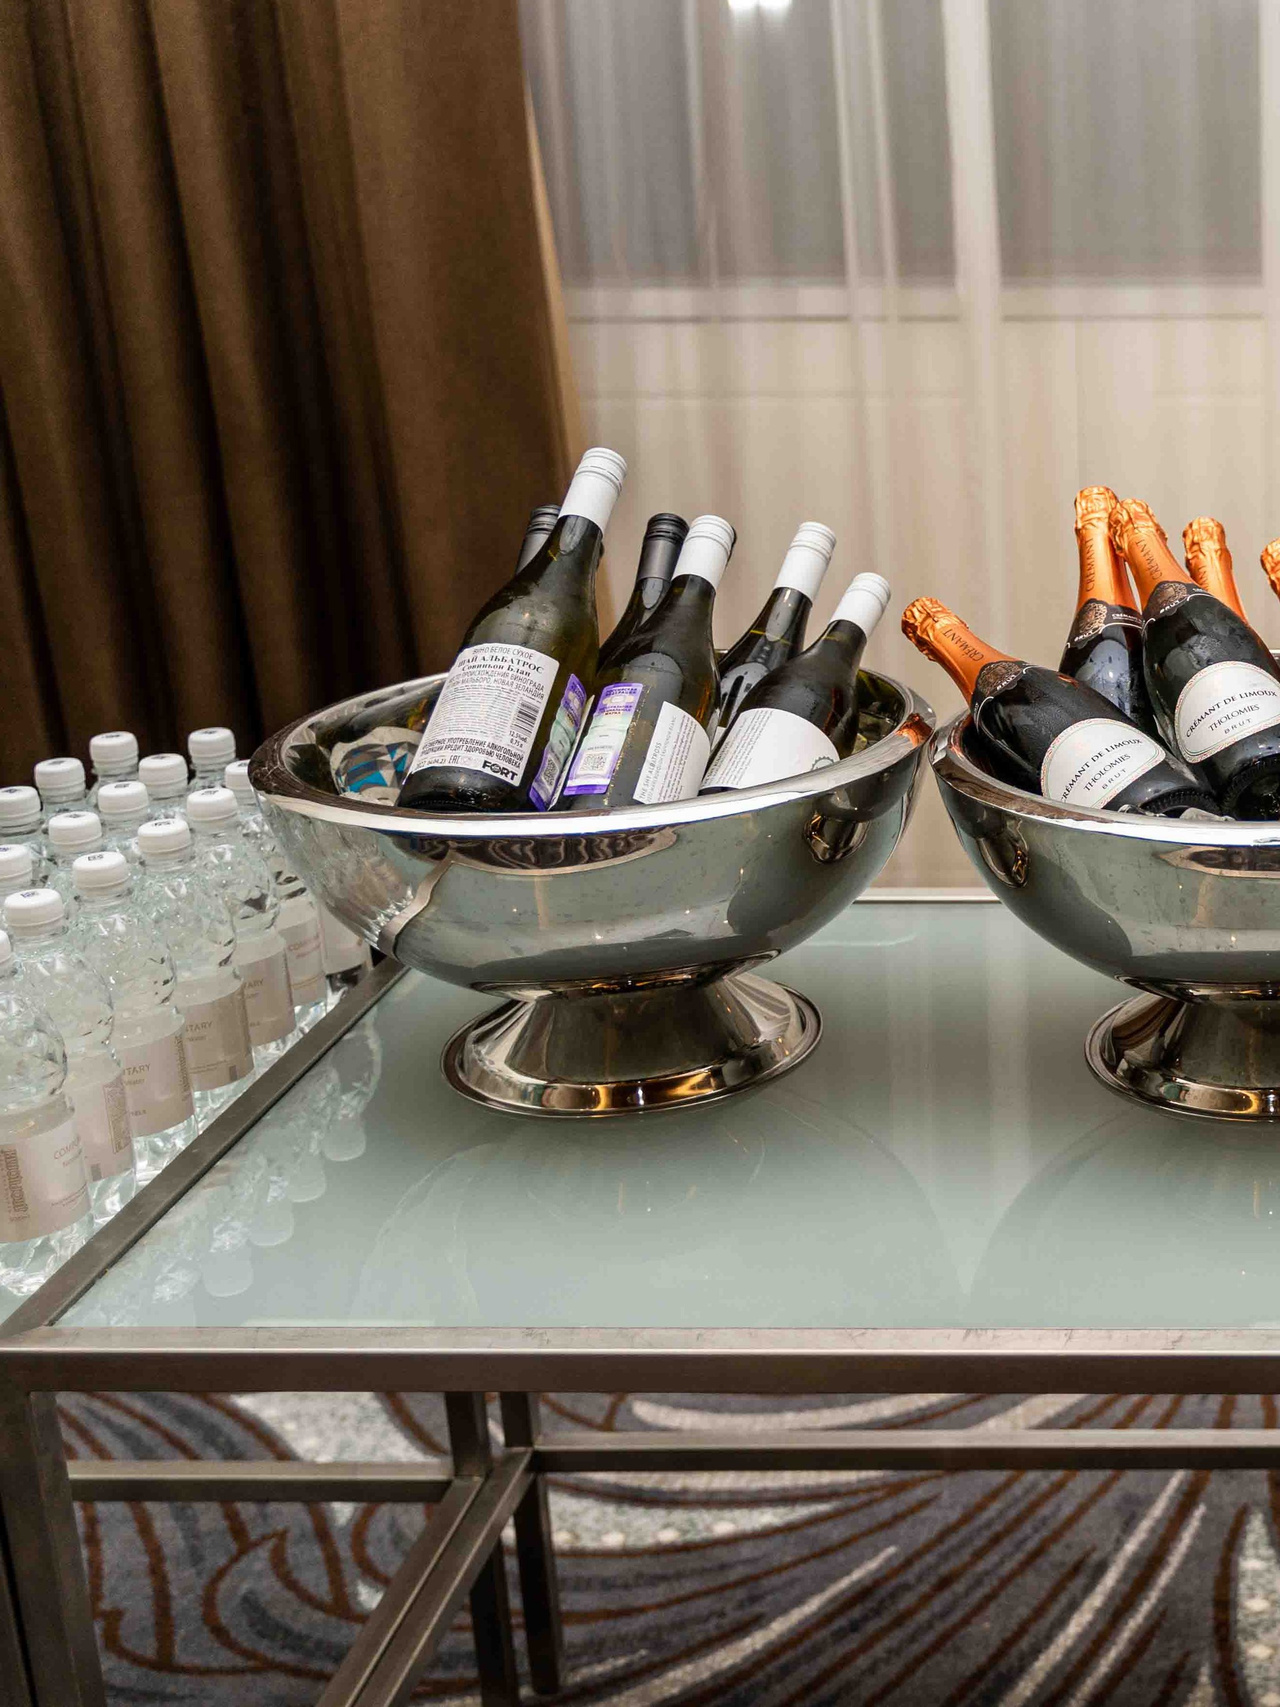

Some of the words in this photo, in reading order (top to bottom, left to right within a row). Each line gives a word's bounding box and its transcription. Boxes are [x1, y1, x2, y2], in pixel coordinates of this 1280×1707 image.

[1136, 539, 1163, 580] CRÉMANT
[489, 645, 511, 655] БЕЛОЕ
[511, 648, 535, 660] СУХОЕ
[942, 628, 984, 662] CRÉMANT
[480, 655, 544, 675] АЛЬБАТРОС
[507, 664, 532, 678] Блан
[511, 672, 545, 692] ВИНОГРАДА
[514, 682, 545, 701] ЗЕЛАНДИЯ
[1186, 701, 1222, 738] CRÉMANT
[1223, 696, 1236, 705] DE
[1239, 690, 1278, 699] LIMOUX
[1224, 718, 1252, 735] BRUT
[446, 737, 487, 749] УПОТРЕБЛЕНИЕ
[487, 742, 524, 762] АЛКОГОЛЬНОЙ
[464, 744, 495, 758] ЗДОРОВЬЮ
[495, 752, 522, 769] ЧЕЛОВЕКА
[646, 741, 662, 774] ALBATROSS
[1091, 750, 1104, 763] DE
[1105, 739, 1142, 754] LIMOUX
[482, 760, 518, 781] FORT
[1101, 769, 1127, 790] BRUT
